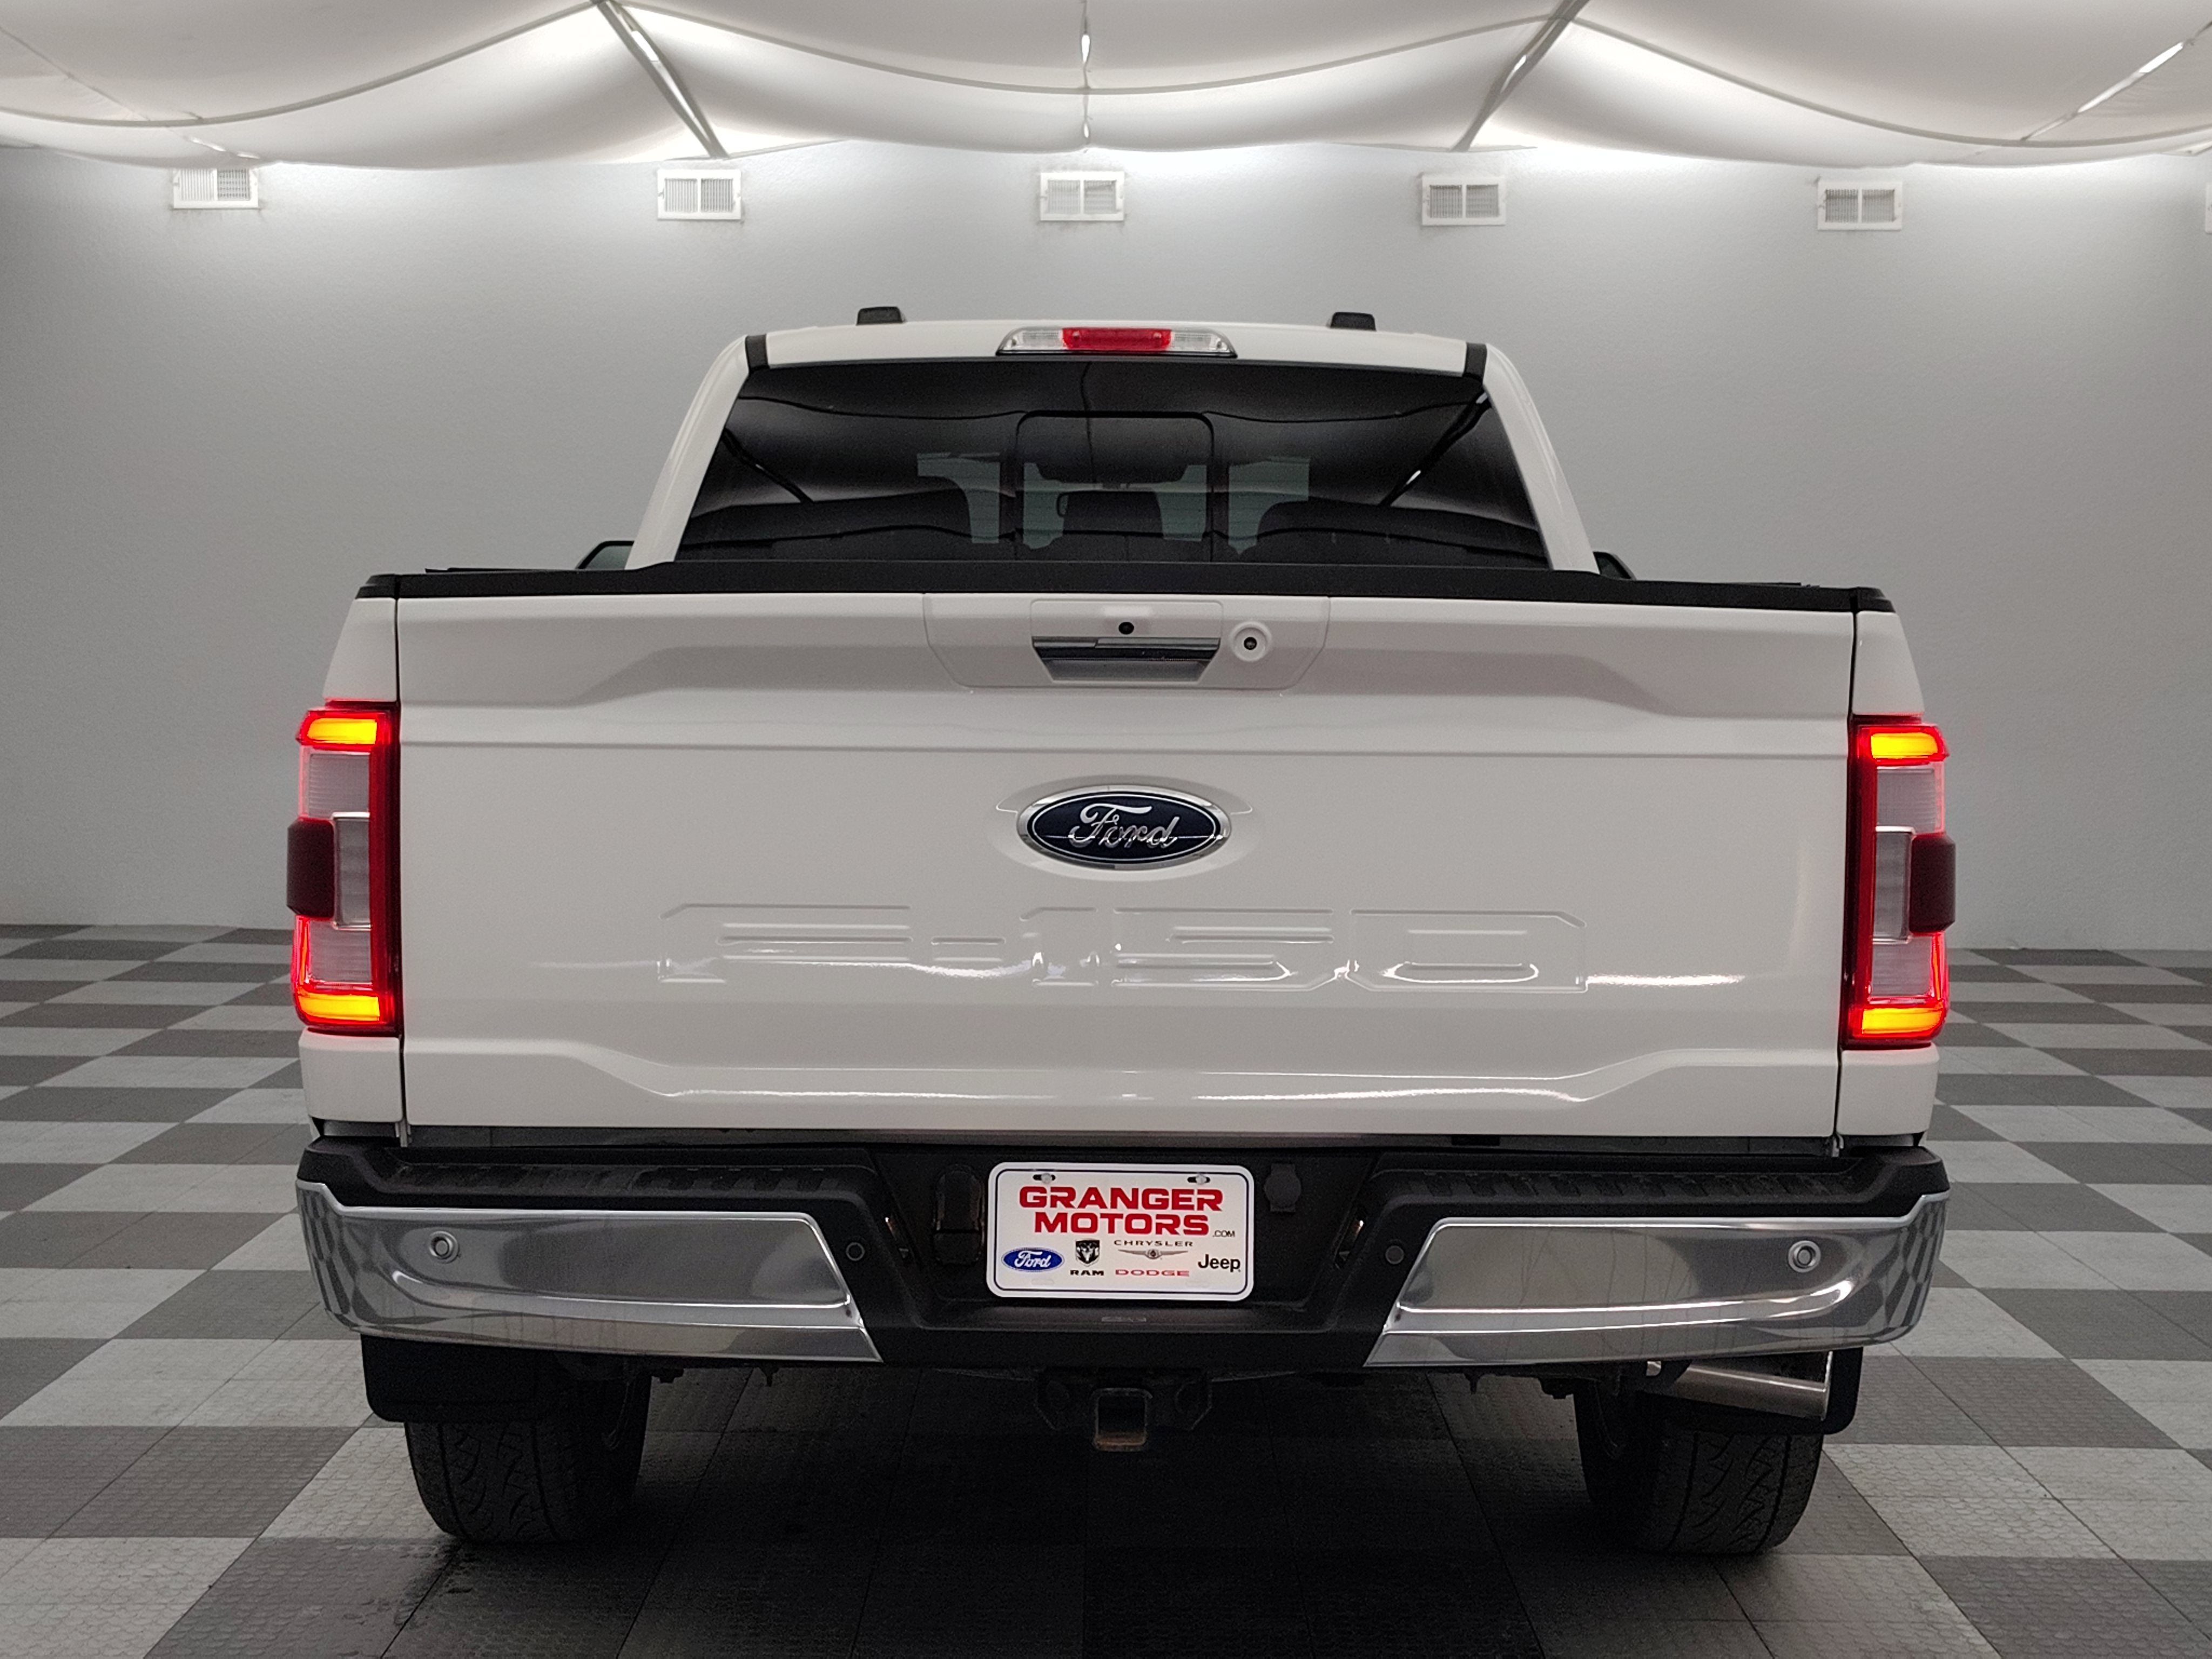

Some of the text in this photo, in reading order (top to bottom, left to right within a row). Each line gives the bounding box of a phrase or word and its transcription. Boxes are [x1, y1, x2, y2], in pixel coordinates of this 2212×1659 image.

[1068, 802, 1180, 848] Ford
[658, 903, 1588, 994] F-150
[1019, 1186, 1223, 1212] GRANGER
[1034, 1211, 1209, 1236] MOTORS
[1014, 1250, 1051, 1267] Ford
[1197, 1254, 1241, 1272] Jeep
